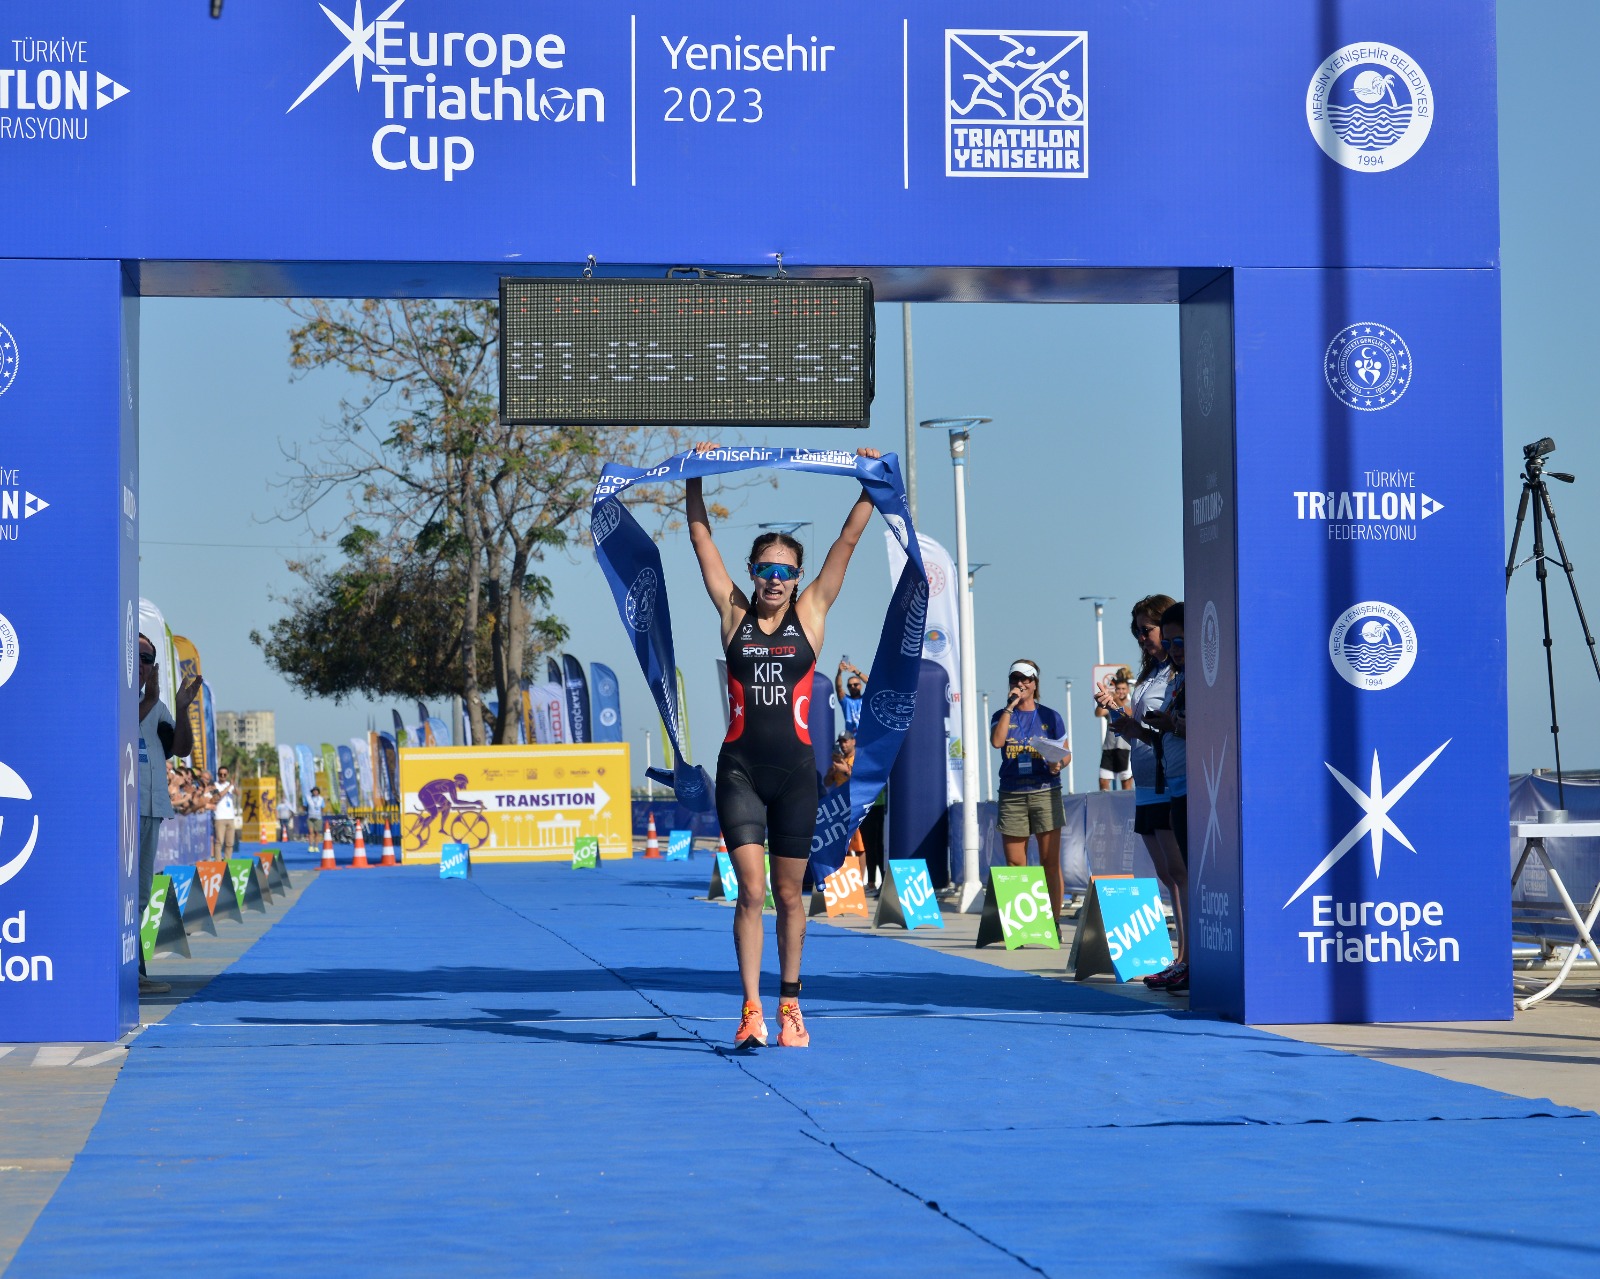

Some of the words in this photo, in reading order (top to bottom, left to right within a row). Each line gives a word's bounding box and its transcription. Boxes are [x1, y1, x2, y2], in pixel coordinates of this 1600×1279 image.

[12, 37, 88, 62] TÜRKİYE
[375, 20, 566, 76] Europe
[661, 34, 836, 72] Yenisehir
[372, 73, 606, 123] Triathlon
[663, 86, 764, 123] 2023
[954, 128, 1080, 149] TRIATHLON
[371, 125, 475, 182] Cup
[954, 148, 1081, 171] YENISEHIR
[1357, 154, 1384, 167] 1994
[1364, 469, 1416, 488] TÜRKİYE
[1328, 524, 1417, 541] FEDERASYONU
[753, 662, 784, 683] KIR
[1365, 678, 1383, 687] 1994
[751, 685, 788, 706] TUR
[495, 792, 596, 808] TRANSITION
[667, 836, 691, 856] SWIM
[439, 850, 469, 873] SWIM
[823, 867, 864, 907] SÜR
[898, 869, 934, 916] YÜZ
[998, 880, 1054, 938] KOŞ
[1201, 884, 1229, 920] Europe
[1312, 895, 1444, 931] Europe
[1106, 894, 1166, 961] SWIM
[1298, 930, 1460, 963] Triathlon
